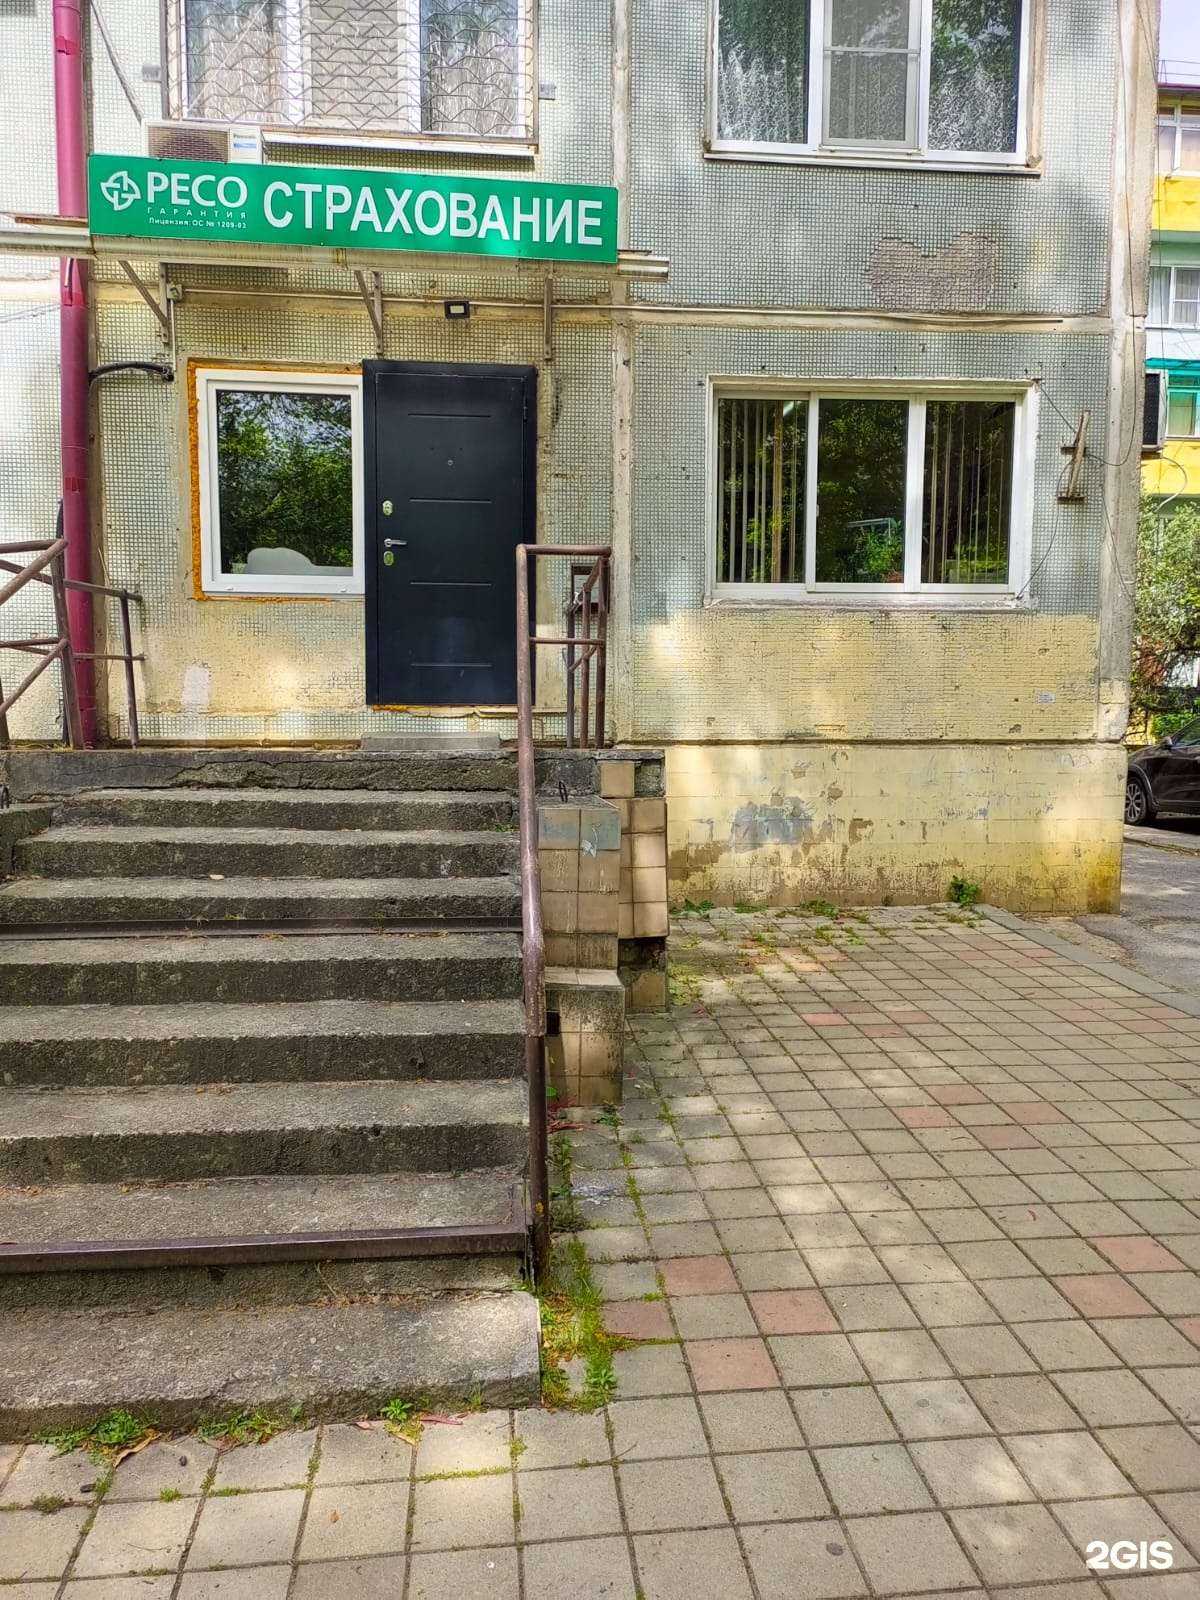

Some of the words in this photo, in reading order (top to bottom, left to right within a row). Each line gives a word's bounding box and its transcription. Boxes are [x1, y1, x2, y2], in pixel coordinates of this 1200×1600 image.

[147, 171, 248, 208] РЕСО
[147, 207, 246, 219] ГАРАНТИЯ
[263, 181, 603, 246] СТРАХОВАНИЕ
